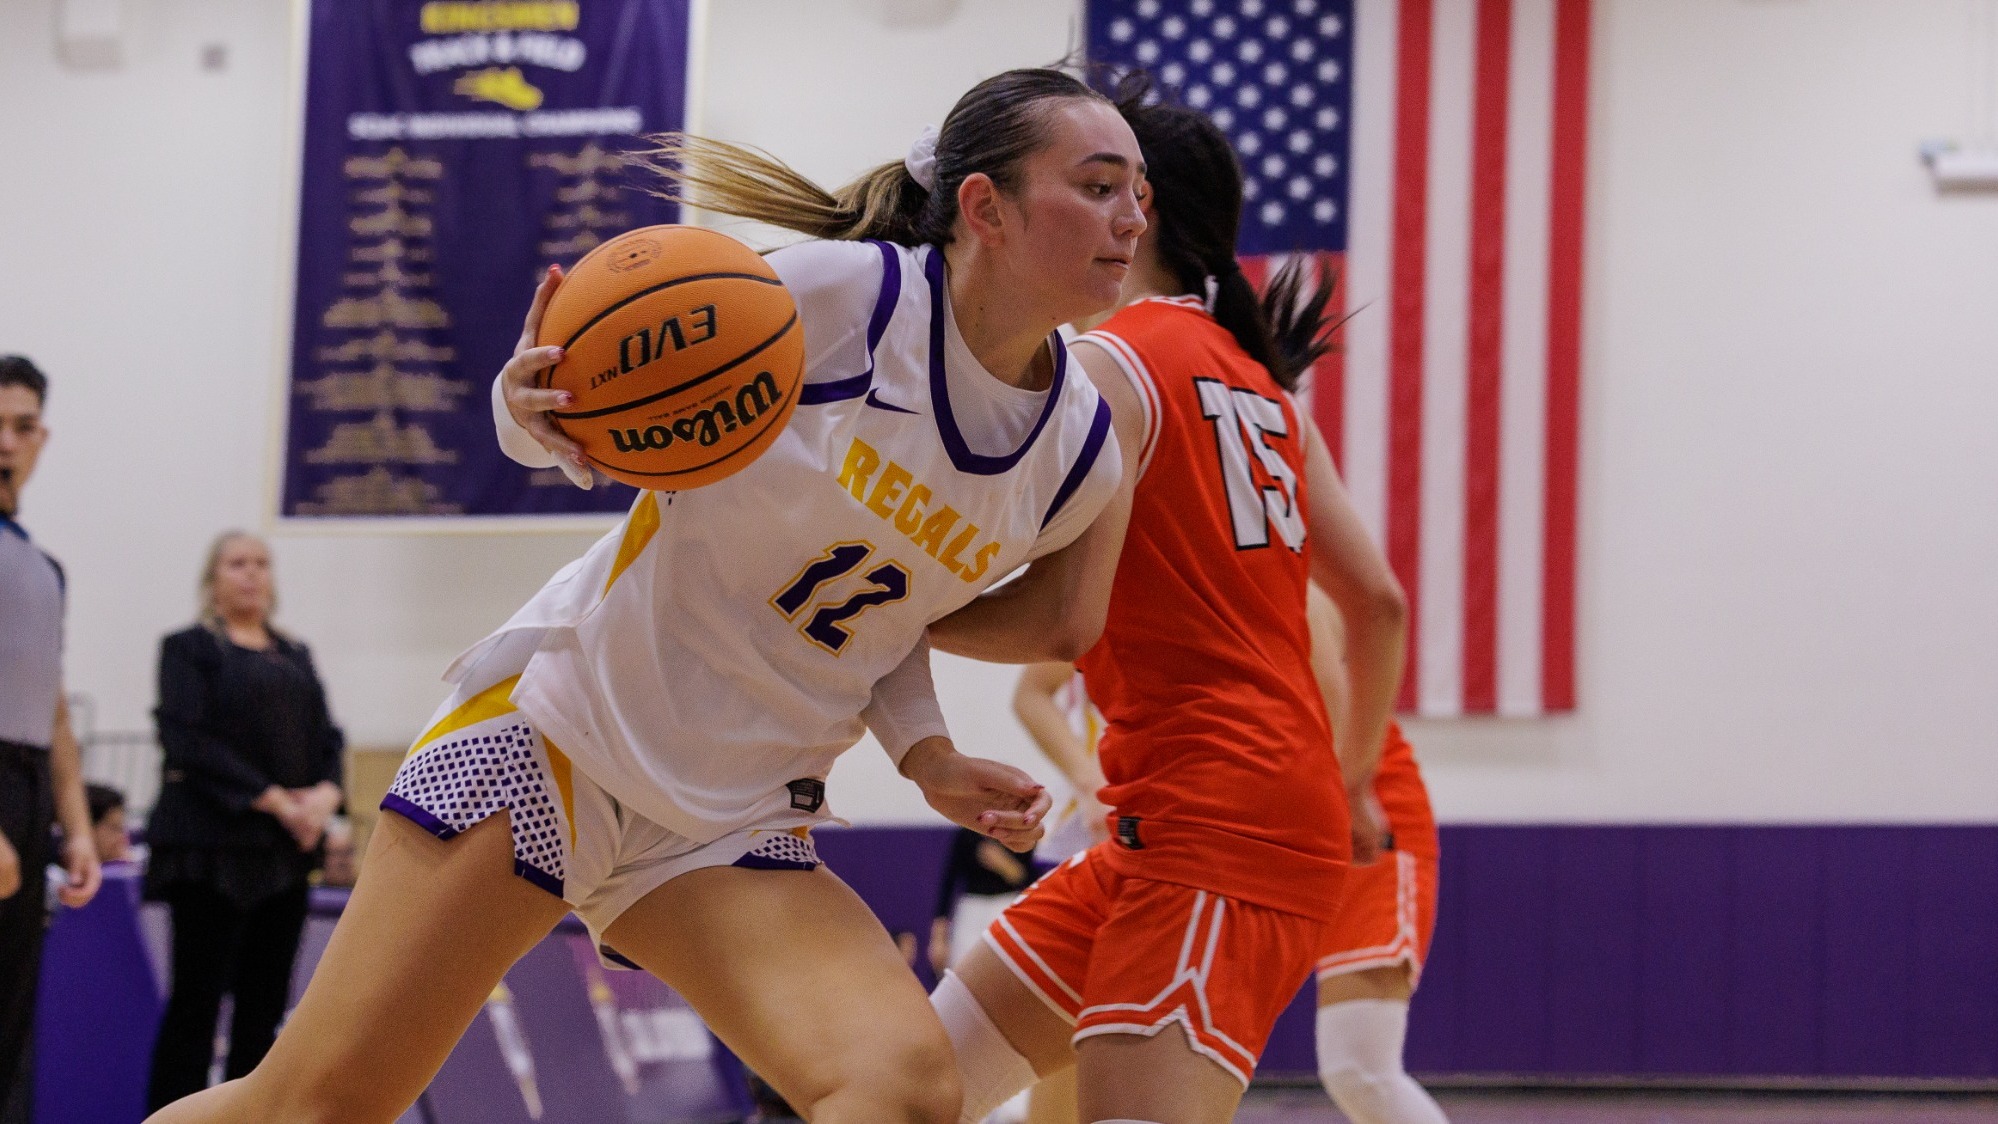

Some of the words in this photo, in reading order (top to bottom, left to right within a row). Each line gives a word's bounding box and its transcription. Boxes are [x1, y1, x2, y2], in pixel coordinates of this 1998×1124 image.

[590, 366, 619, 391] NXT
[618, 303, 718, 375] EVO
[608, 370, 782, 453] Wilson
[836, 436, 1001, 583] REGALS
[1191, 376, 1307, 553] 15
[768, 539, 912, 658] 12
